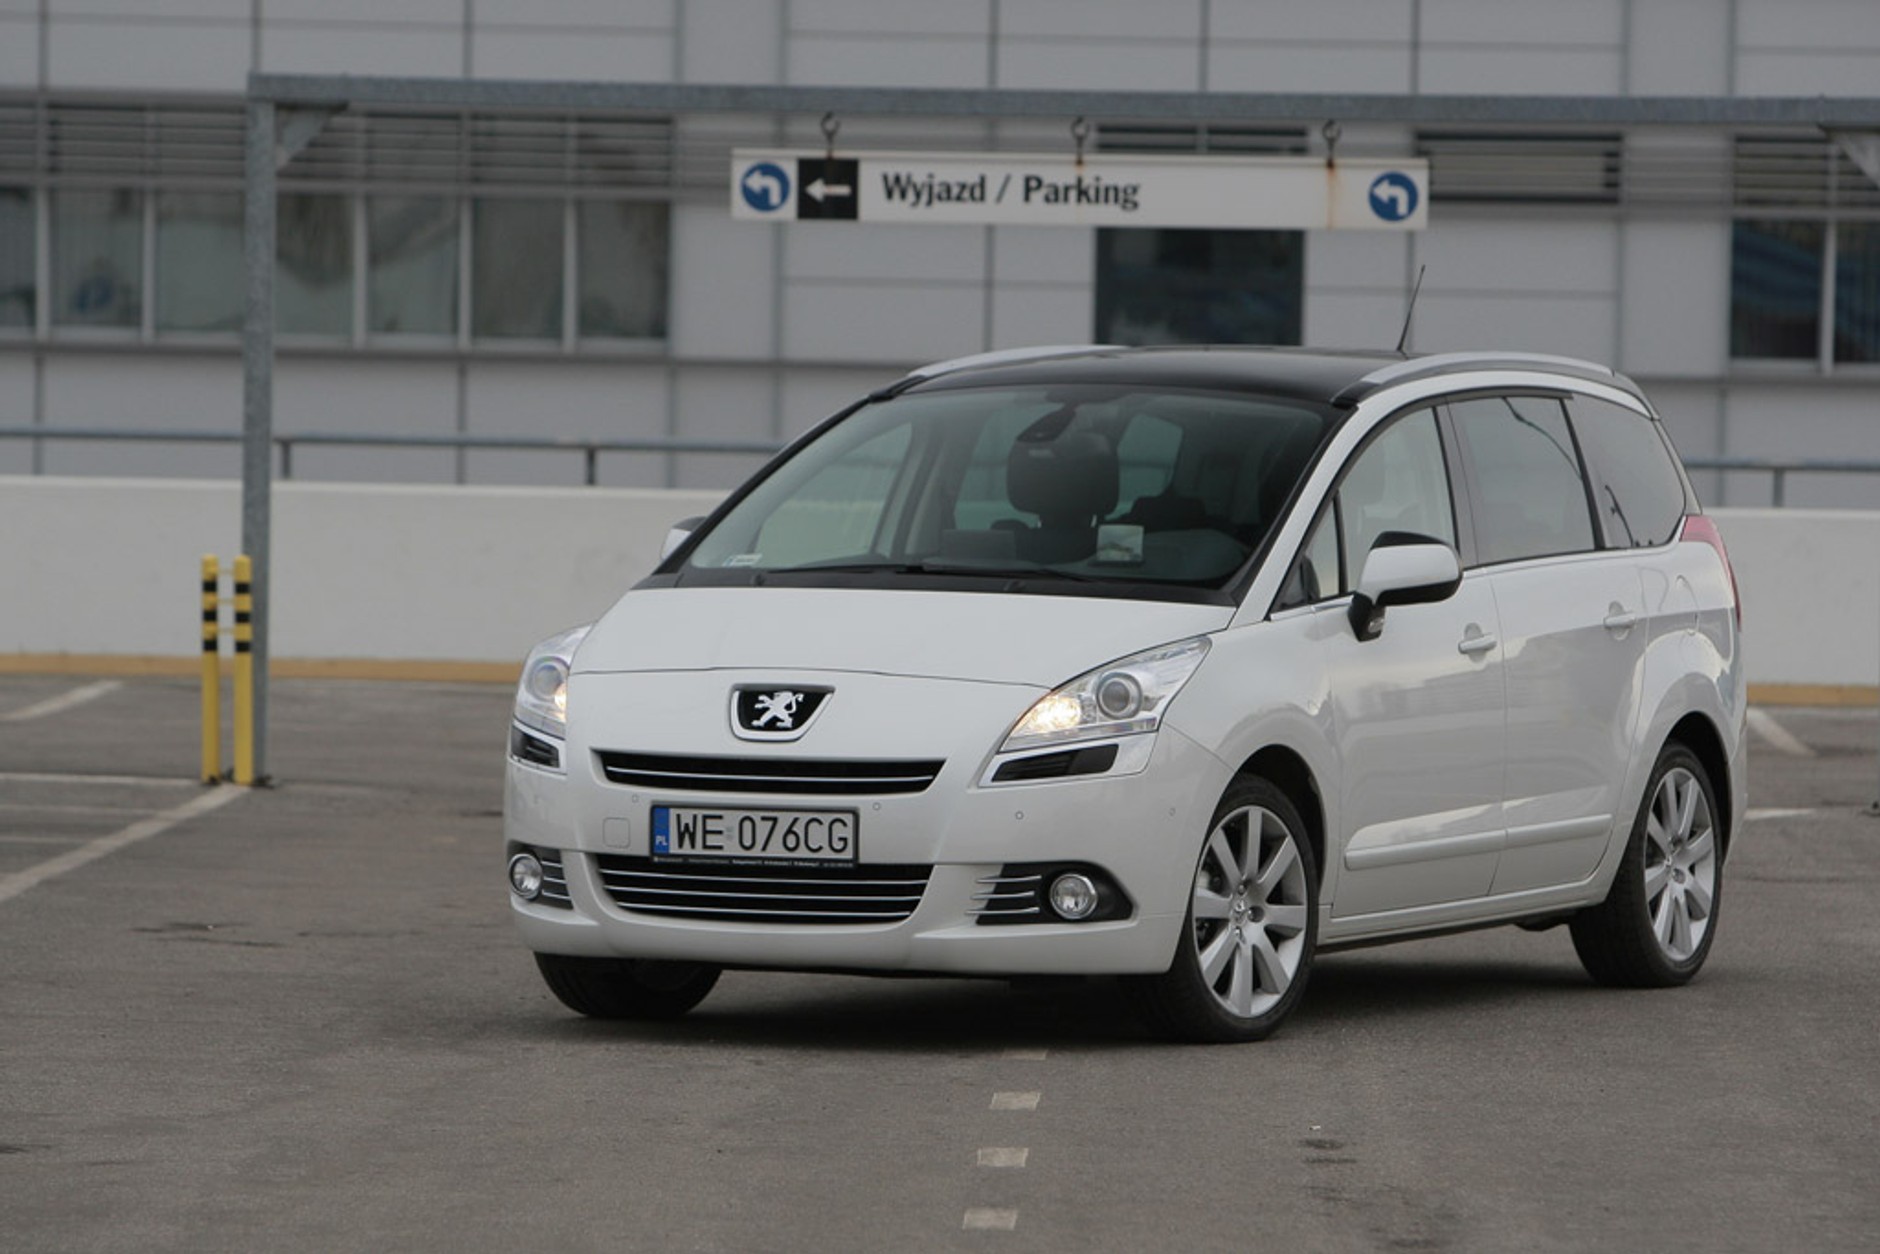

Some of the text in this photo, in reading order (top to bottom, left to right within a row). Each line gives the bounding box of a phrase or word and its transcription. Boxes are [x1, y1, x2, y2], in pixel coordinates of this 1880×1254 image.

[882, 173, 1141, 211] Wyjazd / Parking
[655, 835, 668, 846] PL
[676, 813, 848, 854] WE 076CG
